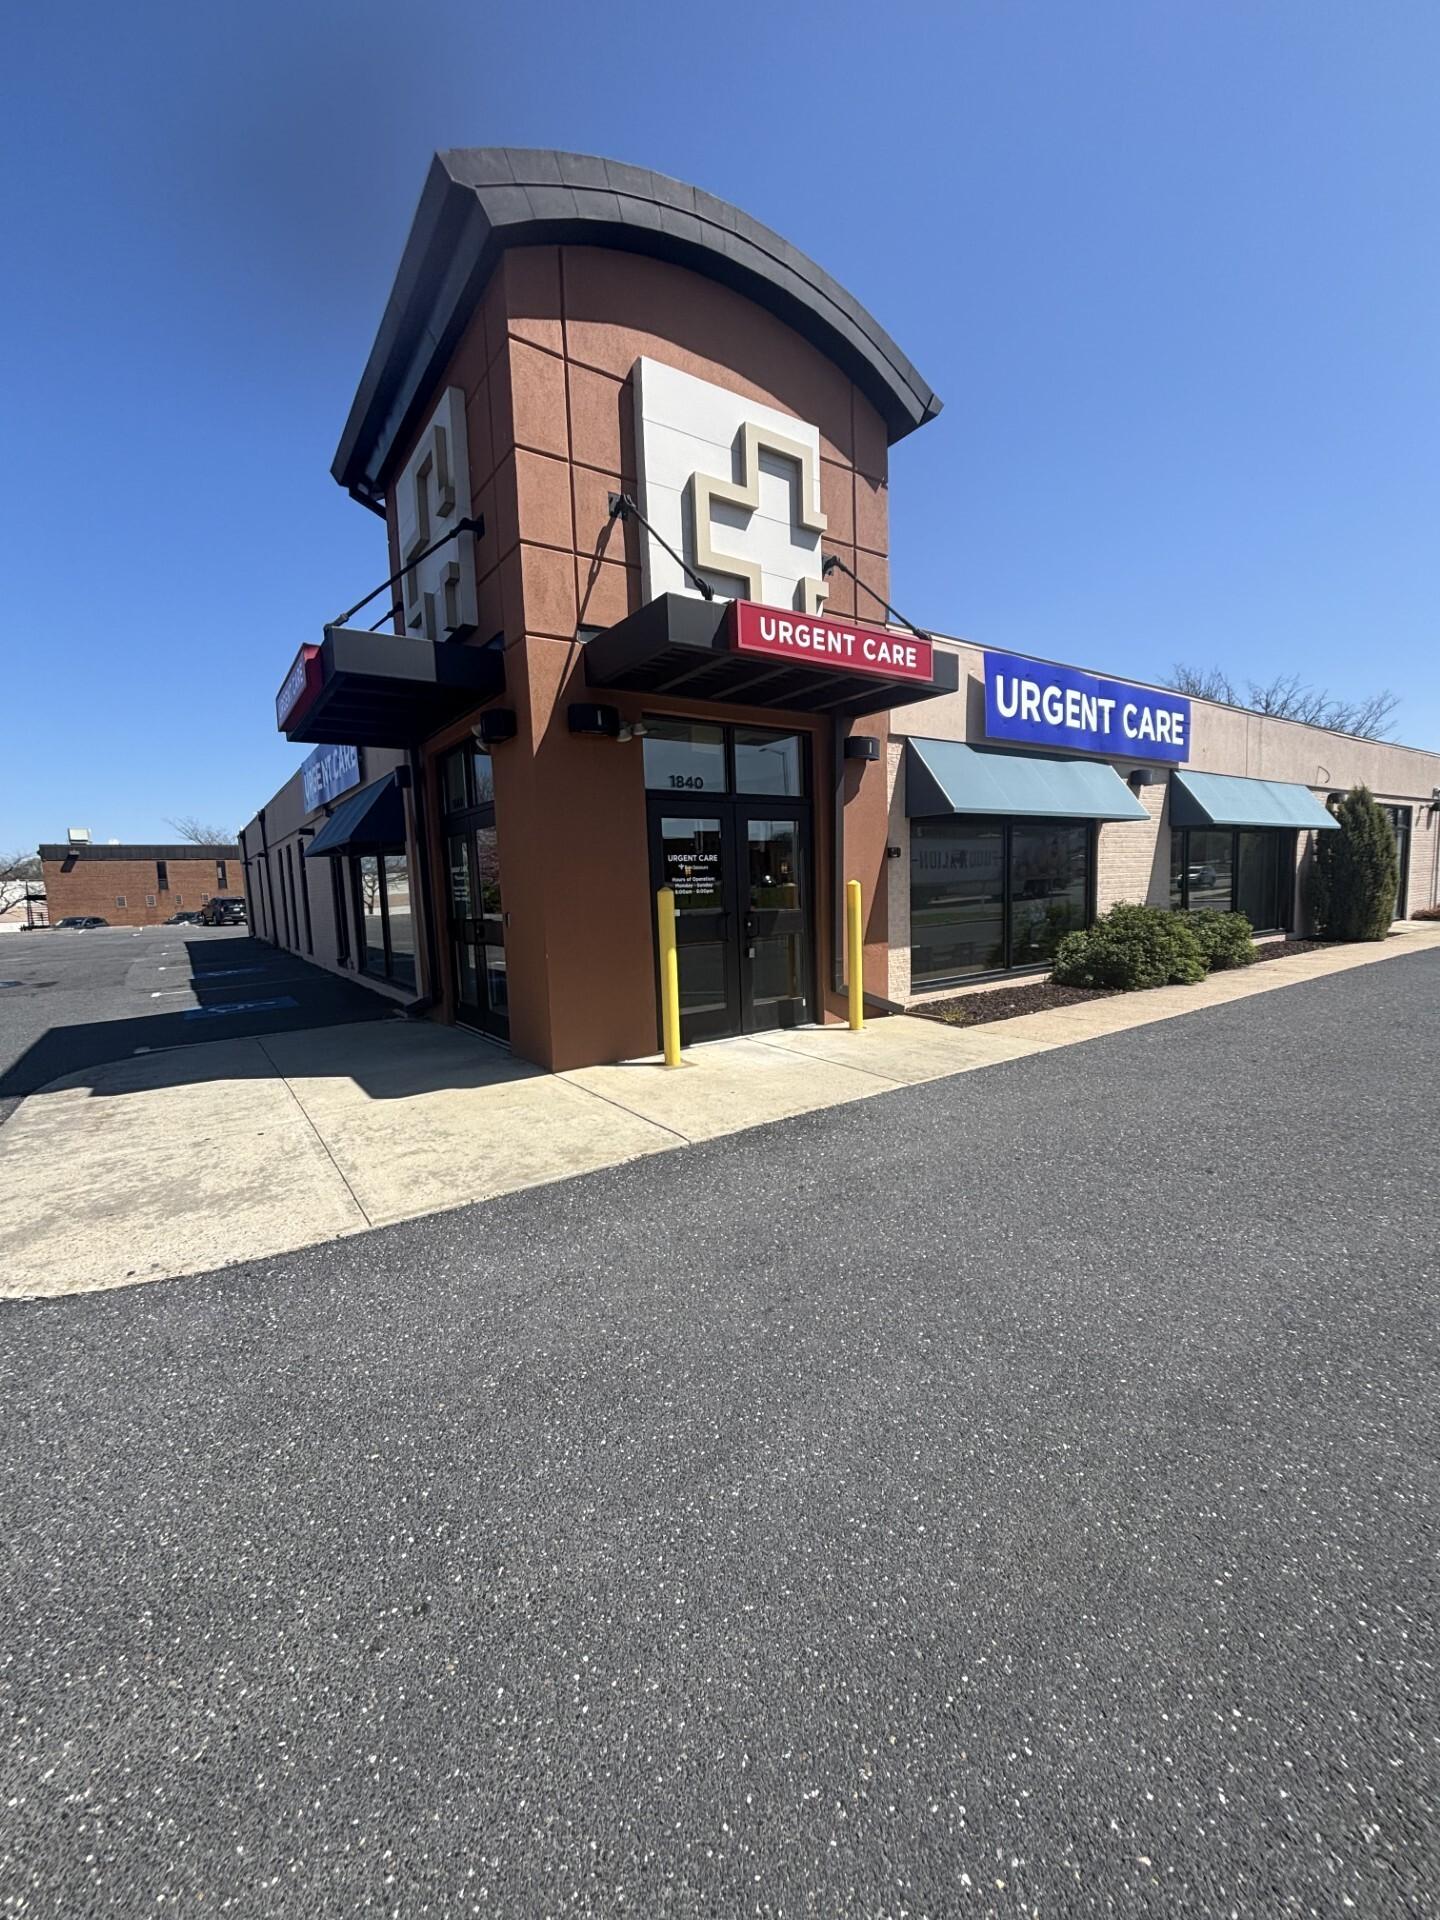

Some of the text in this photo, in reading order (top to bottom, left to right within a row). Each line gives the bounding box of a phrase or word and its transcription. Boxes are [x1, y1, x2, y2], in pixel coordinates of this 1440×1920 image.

[759, 616, 918, 668] URGENT CARE
[995, 674, 1185, 746] URGENT CARE
[669, 775, 704, 789] 1840
